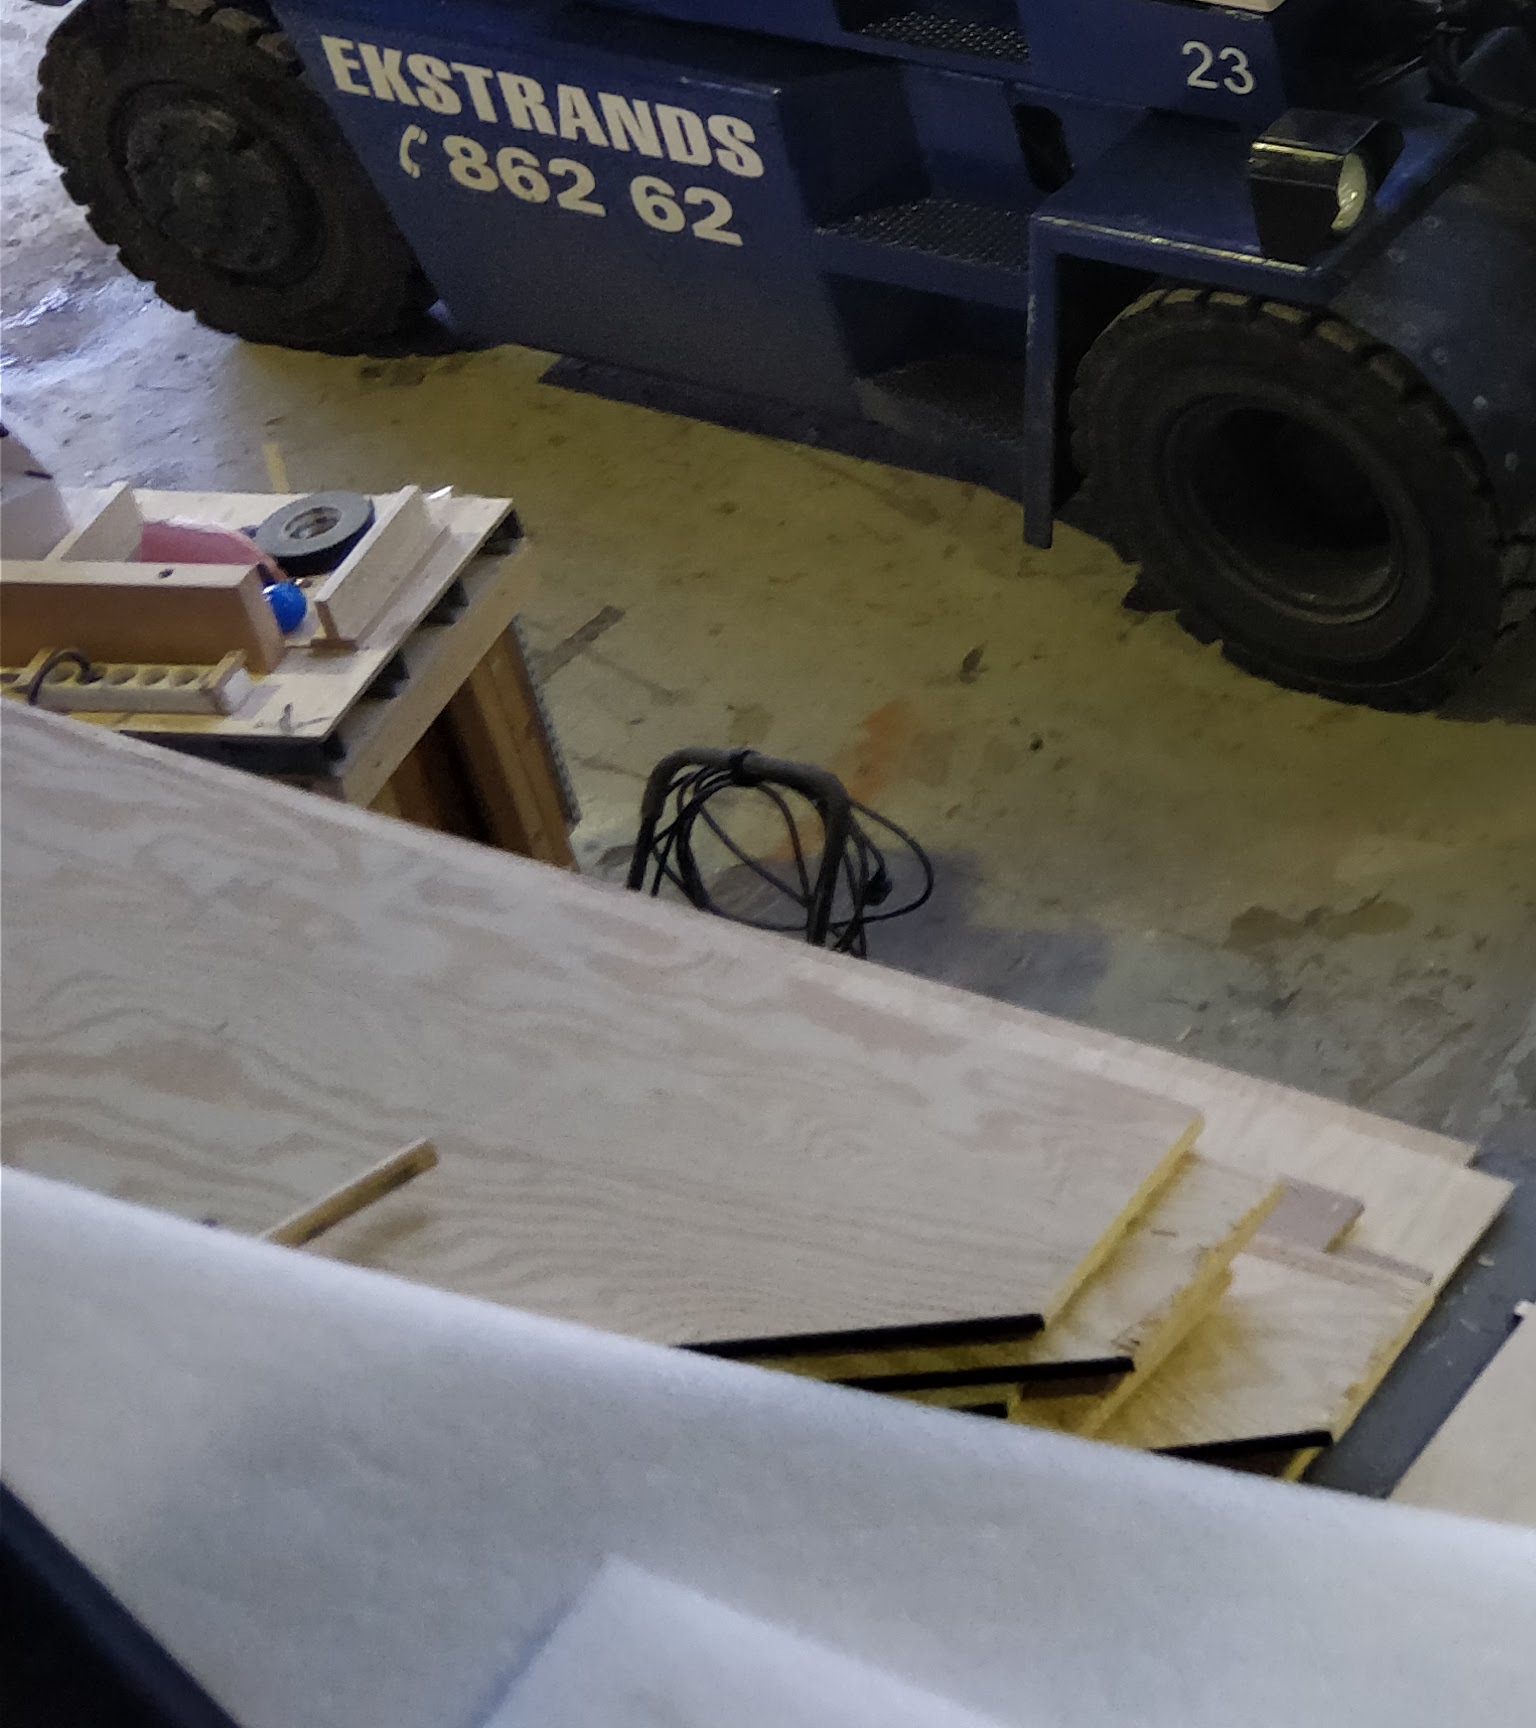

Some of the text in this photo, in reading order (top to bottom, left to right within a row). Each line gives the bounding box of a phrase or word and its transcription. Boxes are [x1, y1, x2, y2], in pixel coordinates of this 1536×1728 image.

[320, 35, 765, 179] EKSTRANDS
[1182, 40, 1256, 95] 23
[441, 134, 743, 247] 862 62
